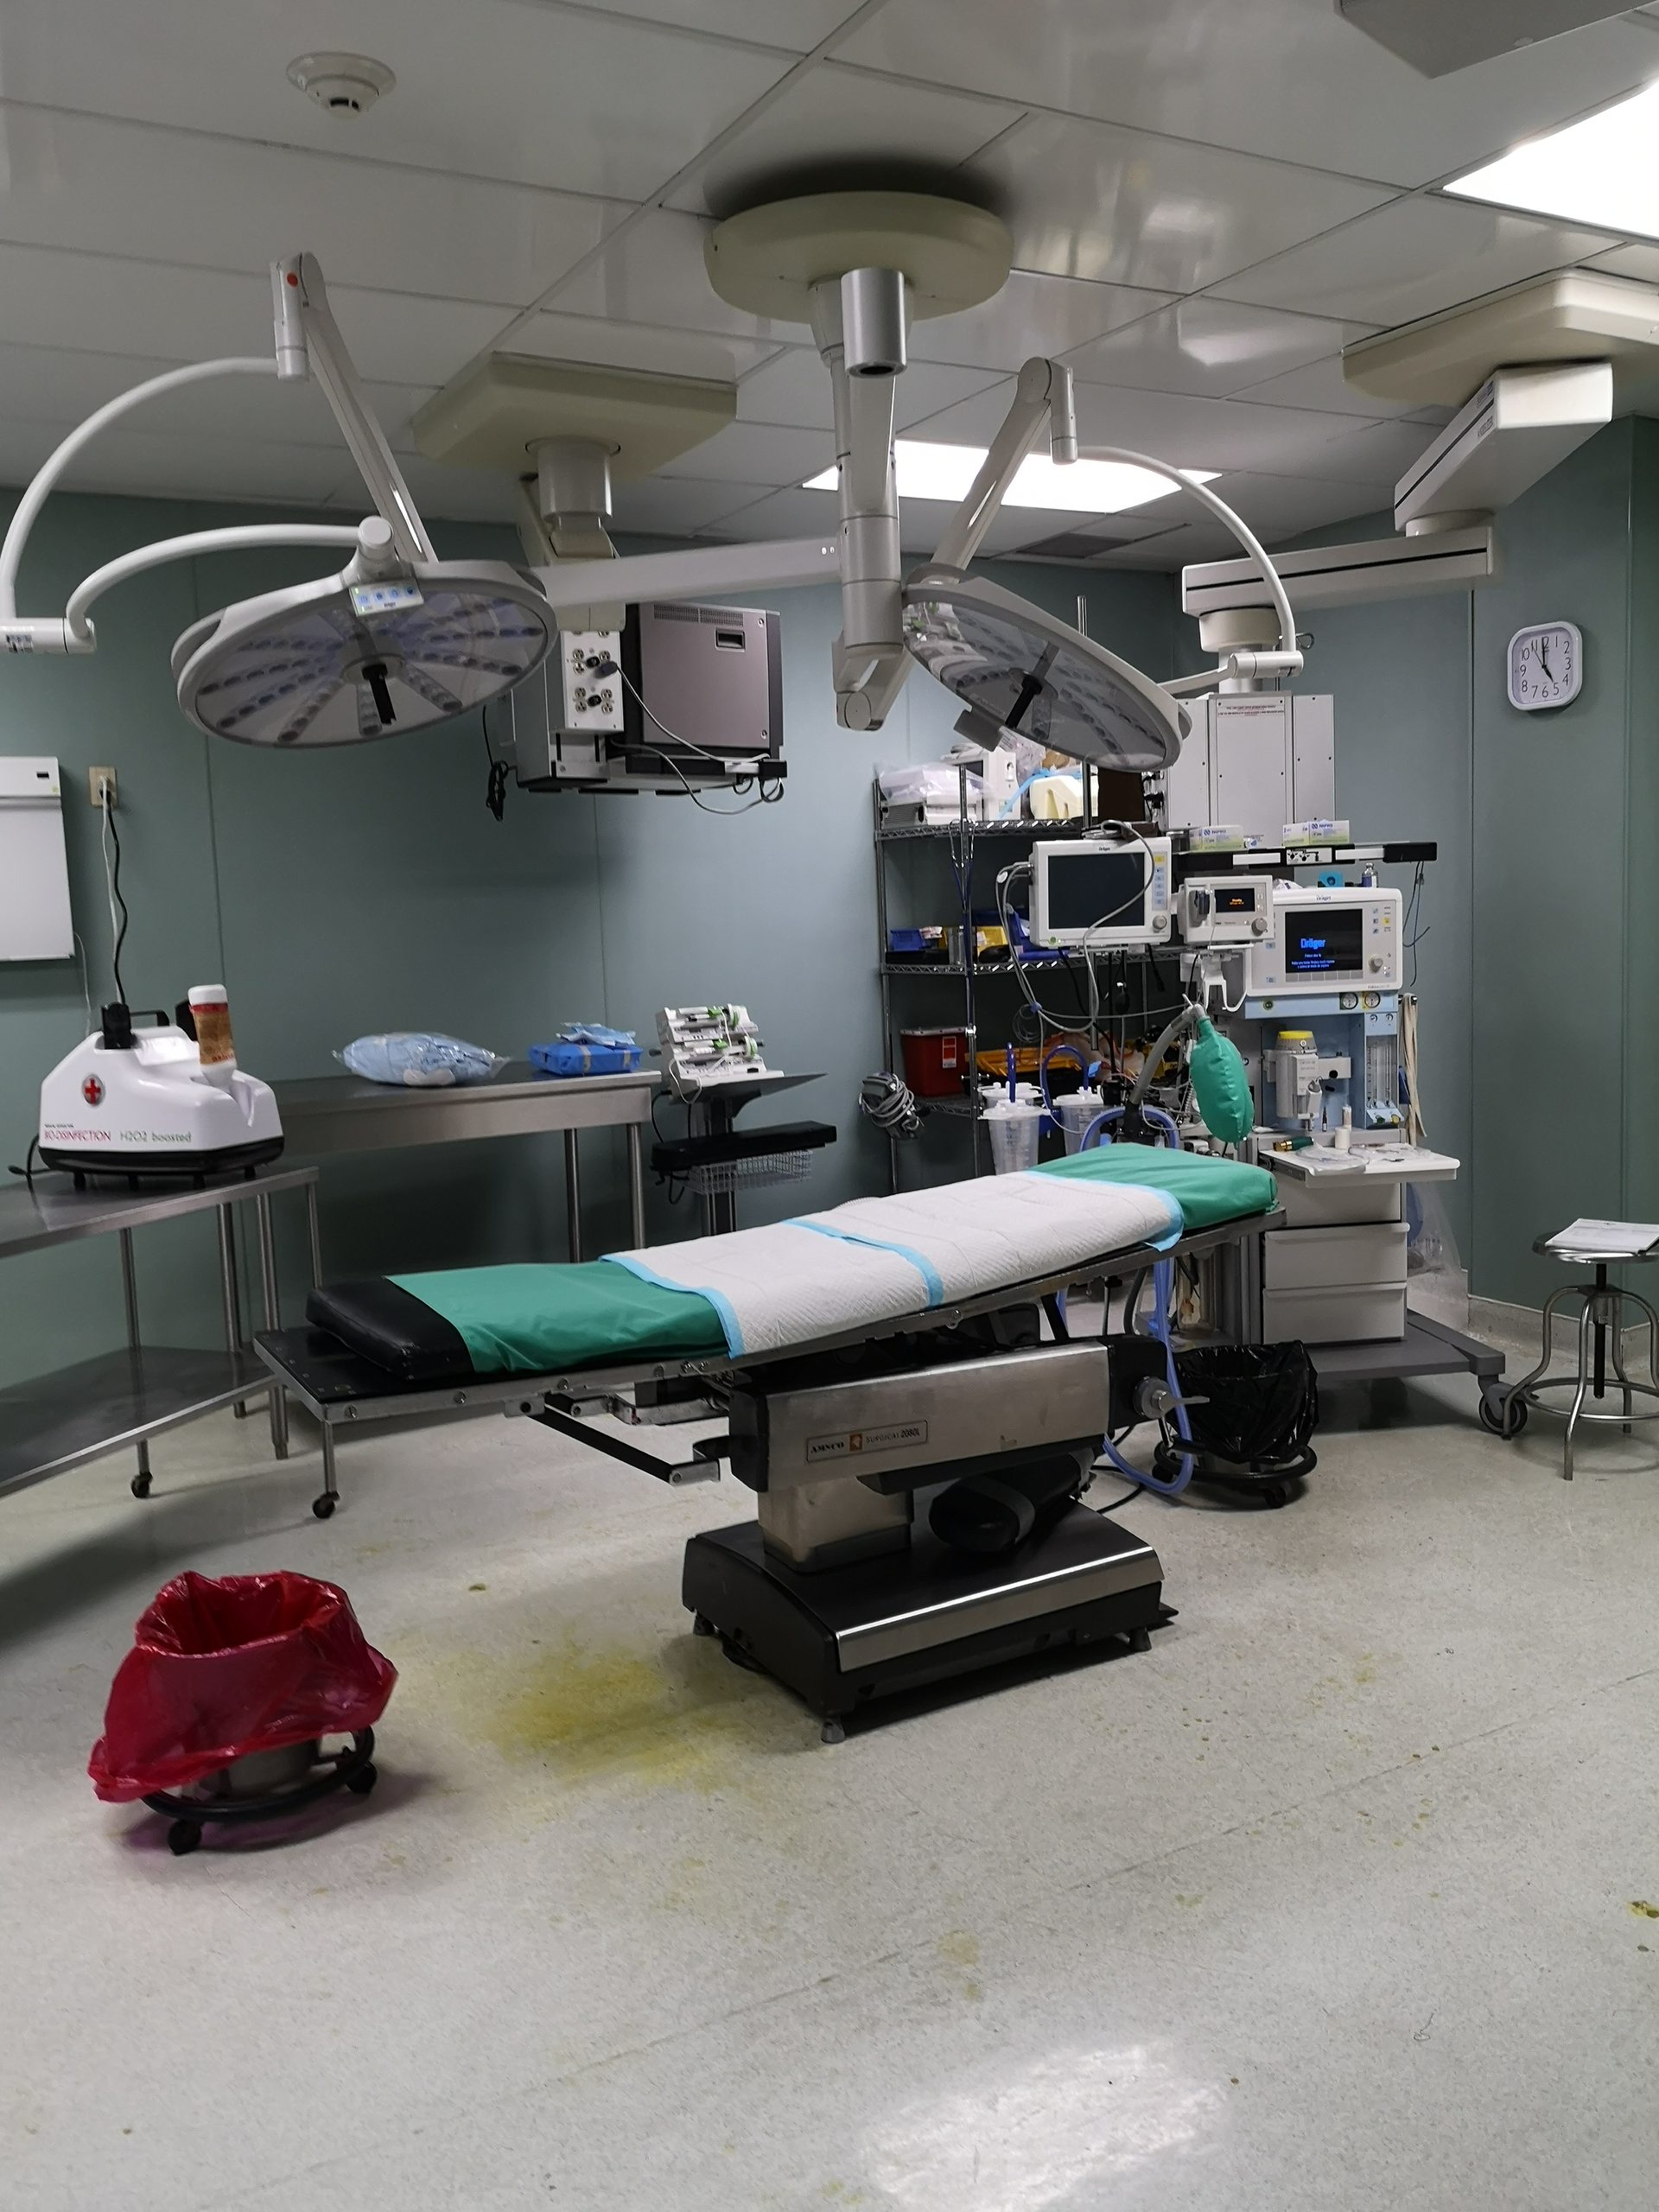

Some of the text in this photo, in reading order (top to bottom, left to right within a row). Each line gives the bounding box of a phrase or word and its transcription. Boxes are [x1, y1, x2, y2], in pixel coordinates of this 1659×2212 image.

[1531, 639, 1538, 652] 11
[1563, 640, 1570, 654] 2
[1521, 647, 1530, 661] 10
[1520, 664, 1527, 677] 9
[1565, 657, 1572, 671] 3
[1522, 680, 1528, 692] 8
[1562, 674, 1568, 686] 4
[1531, 685, 1538, 698] 7
[1541, 685, 1548, 698] 6
[1553, 683, 1560, 696] 5
[1300, 938, 1326, 950] Dräger
